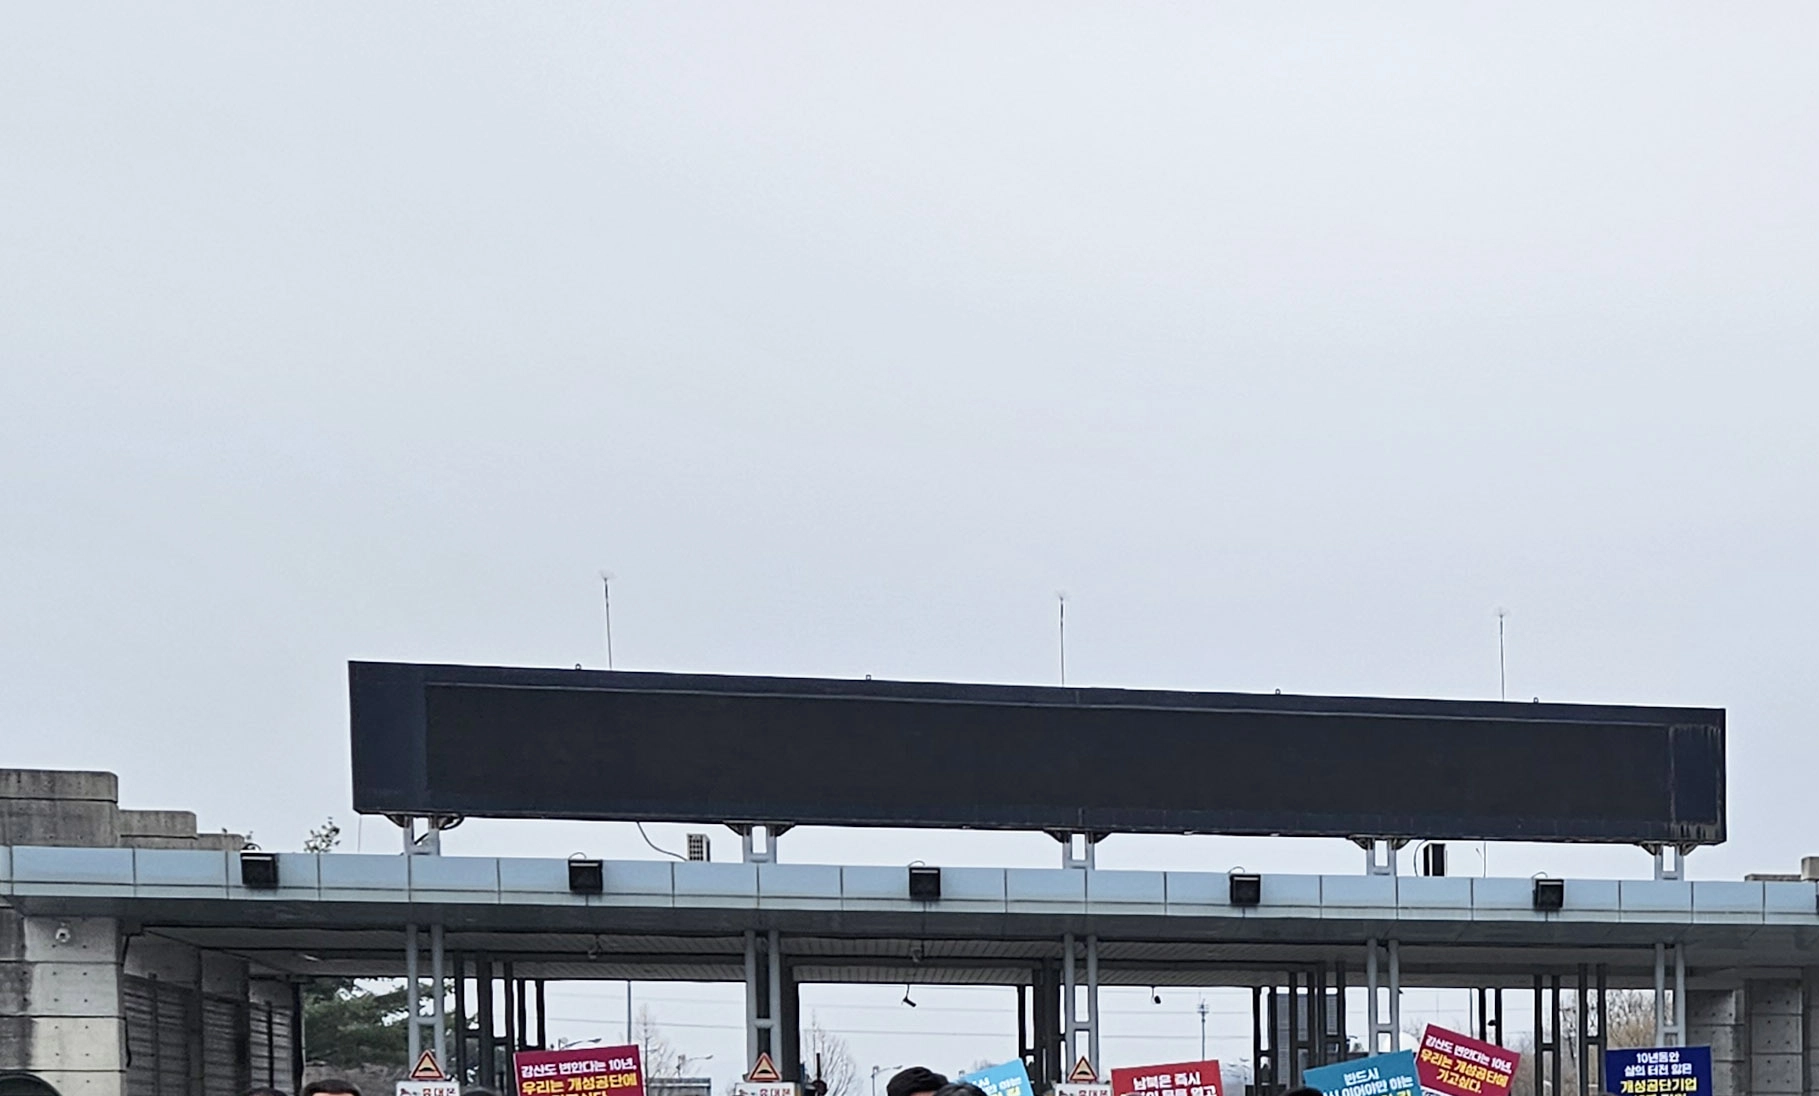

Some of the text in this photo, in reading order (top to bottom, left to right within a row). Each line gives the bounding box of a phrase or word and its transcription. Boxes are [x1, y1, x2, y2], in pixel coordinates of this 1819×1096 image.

[521, 1057, 637, 1078] 강산도 변한다는 10년,
[1636, 1051, 1680, 1064] 10년동안
[1343, 1067, 1379, 1086] 반드시
[1421, 1048, 1509, 1088] 우리는 개성공단에
[522, 1073, 637, 1095] 우리는 개성공단에
[1133, 1071, 1201, 1091] 남북은 즉시
[1389, 1075, 1414, 1090] 하는
[1436, 1068, 1482, 1094] 가고싶다.
[1620, 1077, 1697, 1093] 개성공단기업
